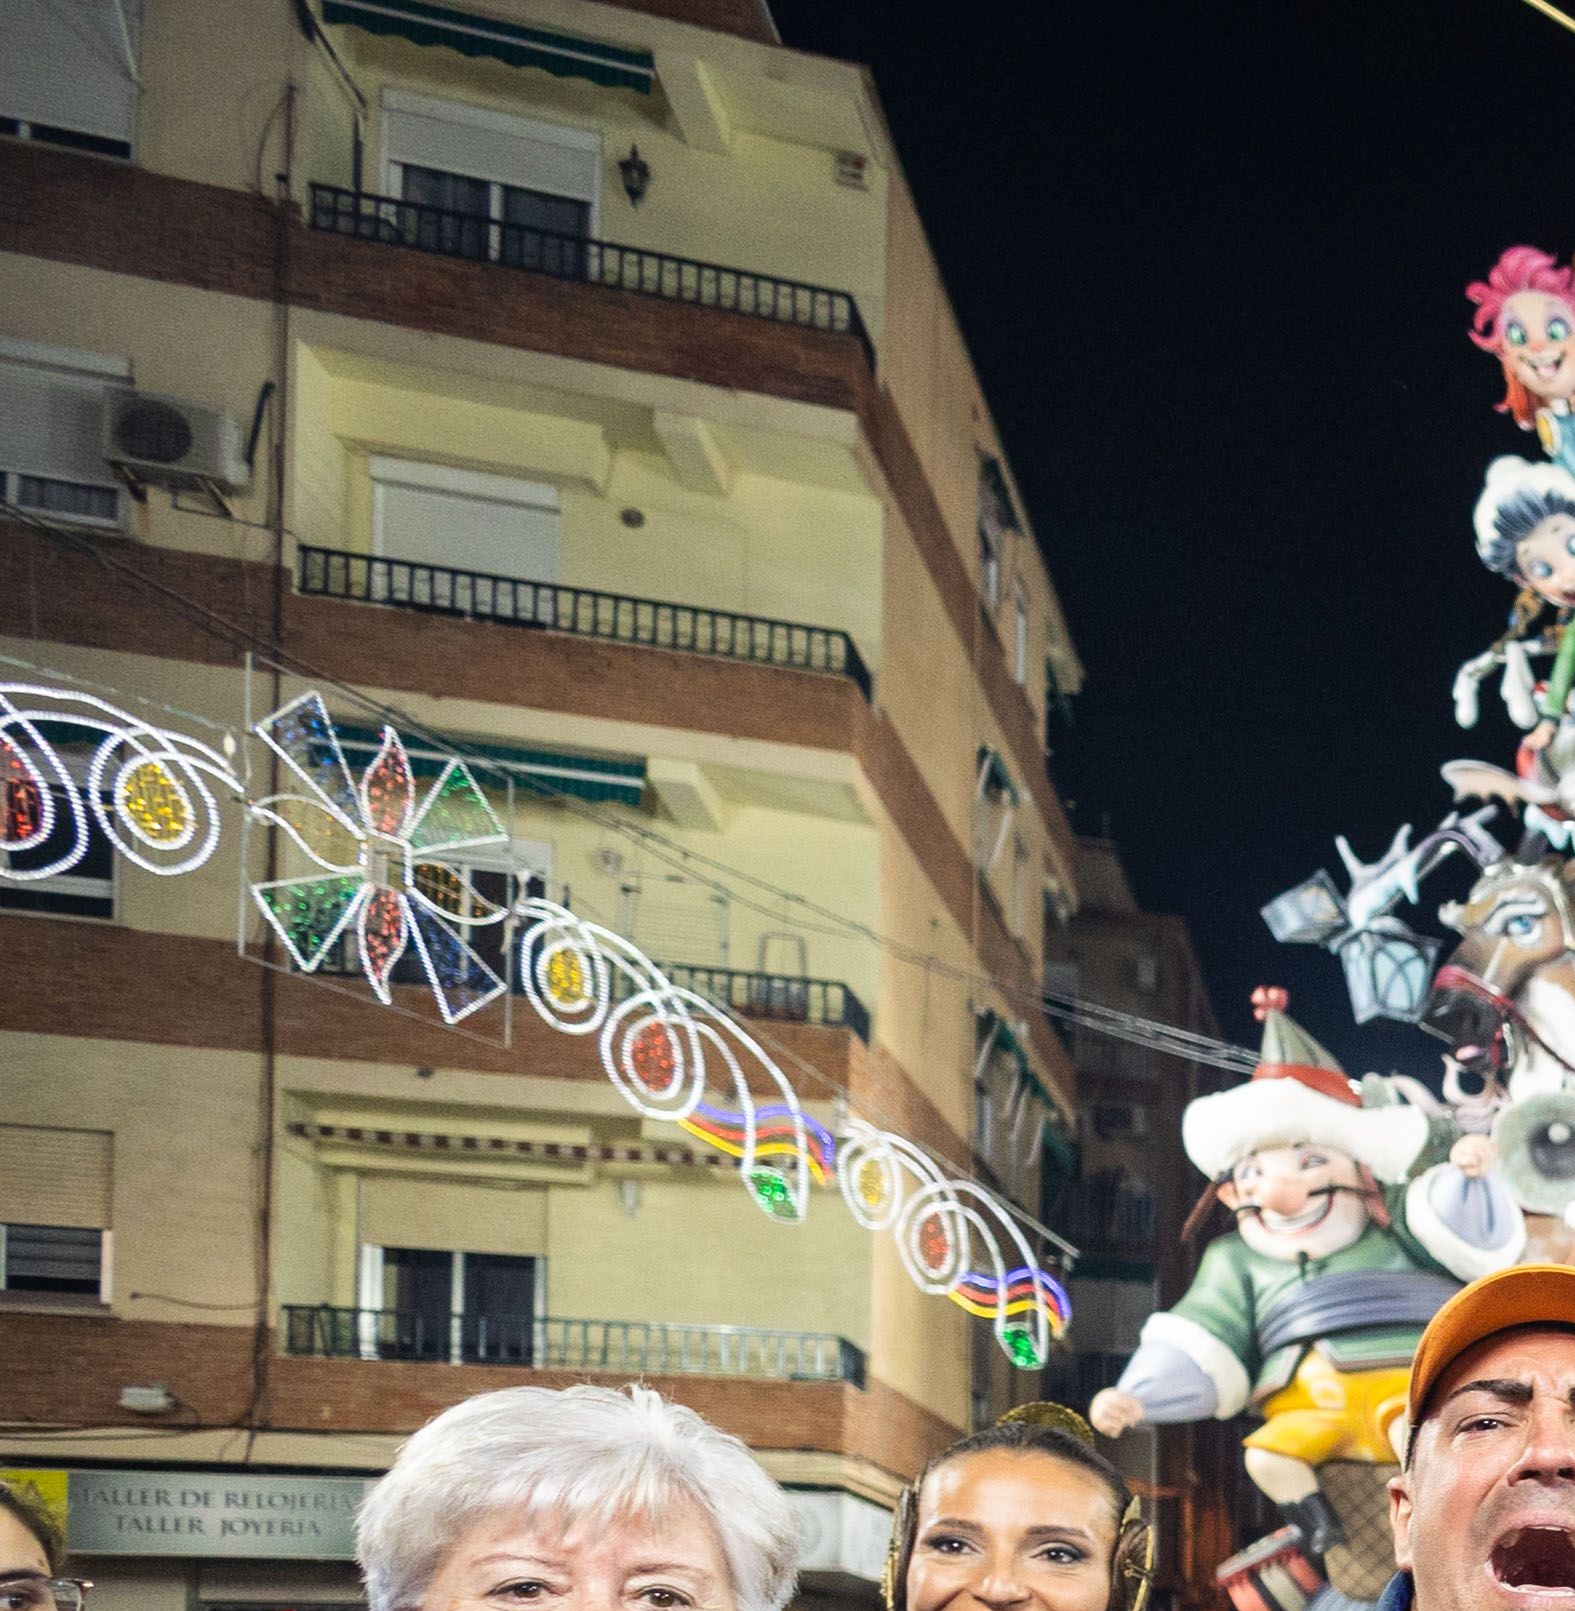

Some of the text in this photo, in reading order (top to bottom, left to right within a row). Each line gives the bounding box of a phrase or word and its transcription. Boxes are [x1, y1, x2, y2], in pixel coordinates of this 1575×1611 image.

[83, 1486, 172, 1508] TALLER
[180, 1489, 216, 1509] DE
[115, 1514, 322, 1538] TALLER JOYERIA
